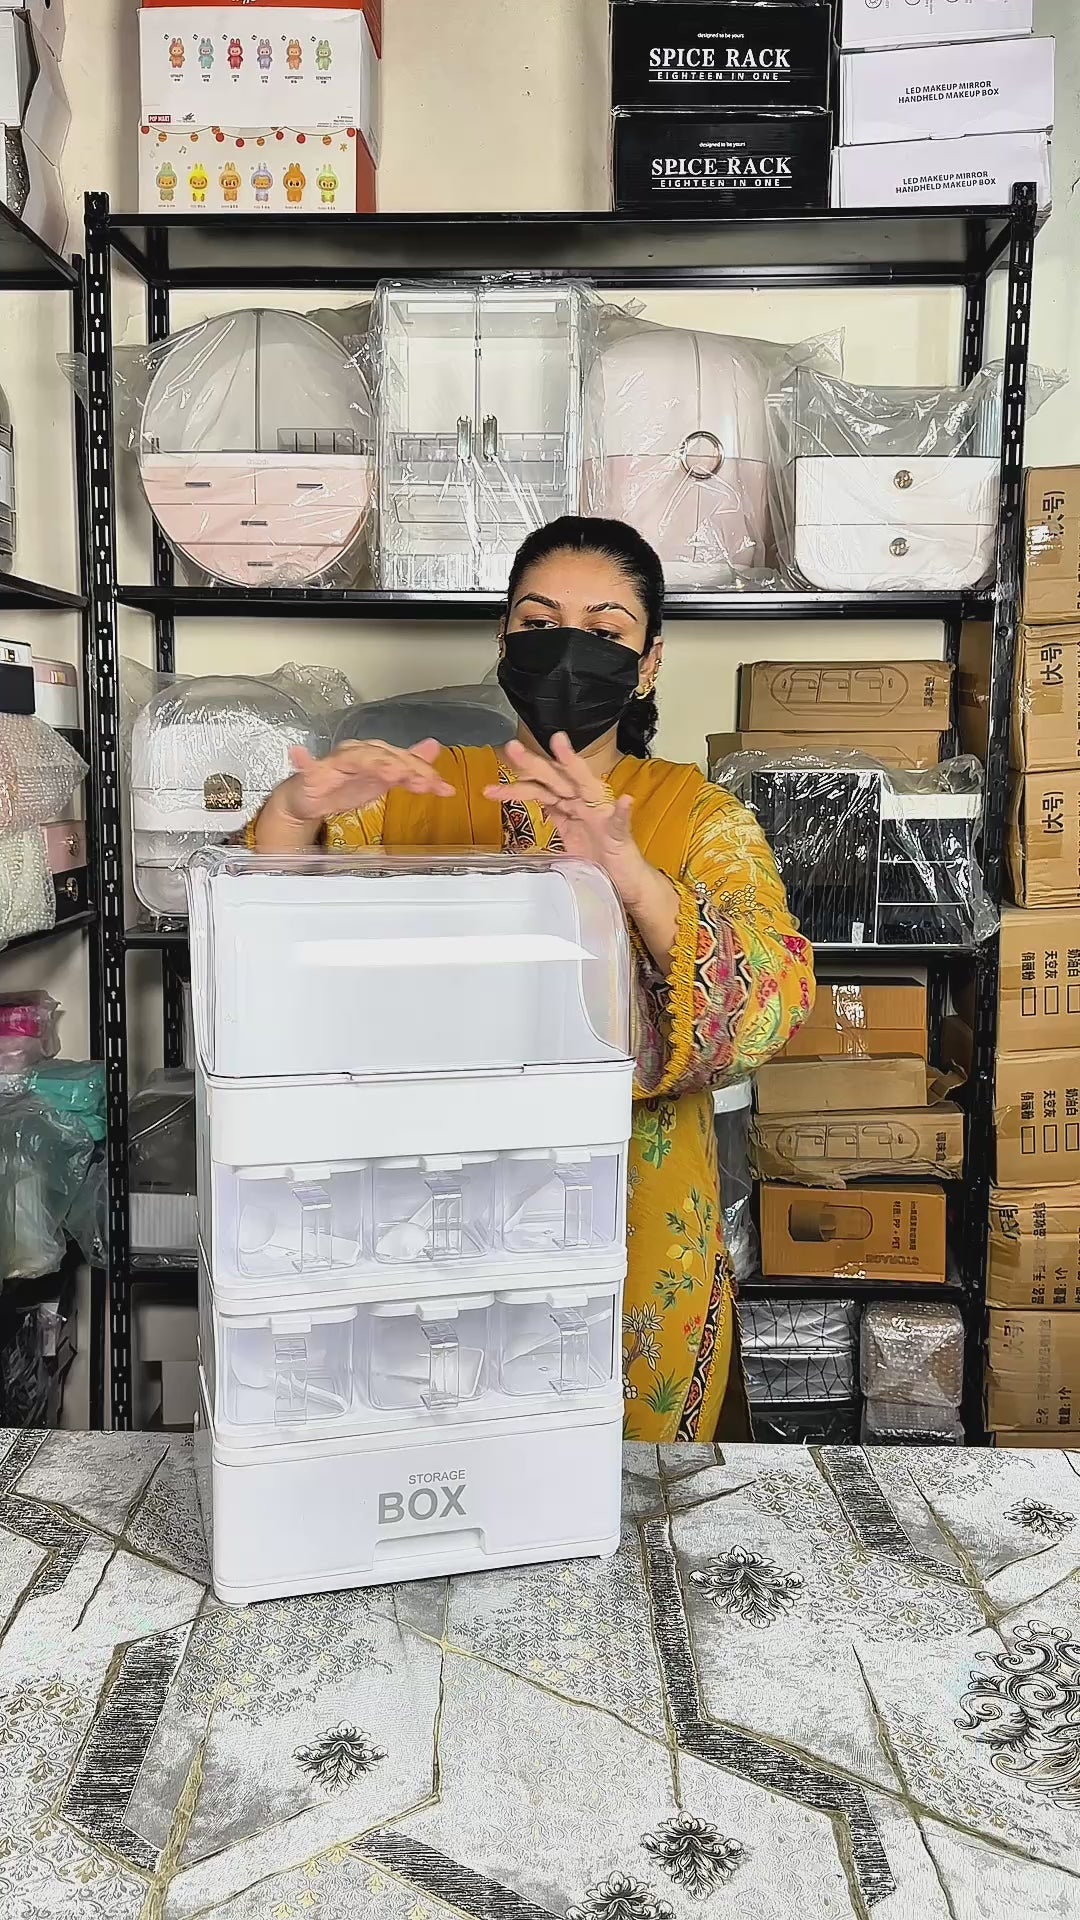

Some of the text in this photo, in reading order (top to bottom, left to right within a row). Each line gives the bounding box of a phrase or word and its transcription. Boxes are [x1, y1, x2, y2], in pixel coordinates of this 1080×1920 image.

[649, 47, 791, 68] SPICE RACK
[657, 72, 779, 81] EIGHTEEN IN ONE
[905, 80, 992, 95] LED MAKEUP MIRROR
[898, 88, 1000, 104] HANDHELD MAKEUP BOX
[651, 157, 792, 176] SPICE RACK
[660, 178, 780, 188] EIGHTEEN IN ONE
[895, 178, 997, 194] HANDHELD MAKEUP BOX
[903, 171, 988, 185] LED MAKEUP MIRROR
[1040, 642, 1064, 686] (大号)
[1041, 791, 1064, 834] (大号)
[1044, 950, 1059, 979] 天空灰
[1043, 1090, 1057, 1118] 天空灰
[892, 1218, 901, 1229] PP
[891, 1236, 901, 1250] PET
[408, 1469, 466, 1485] STORAGE
[378, 1484, 467, 1525] BOX
